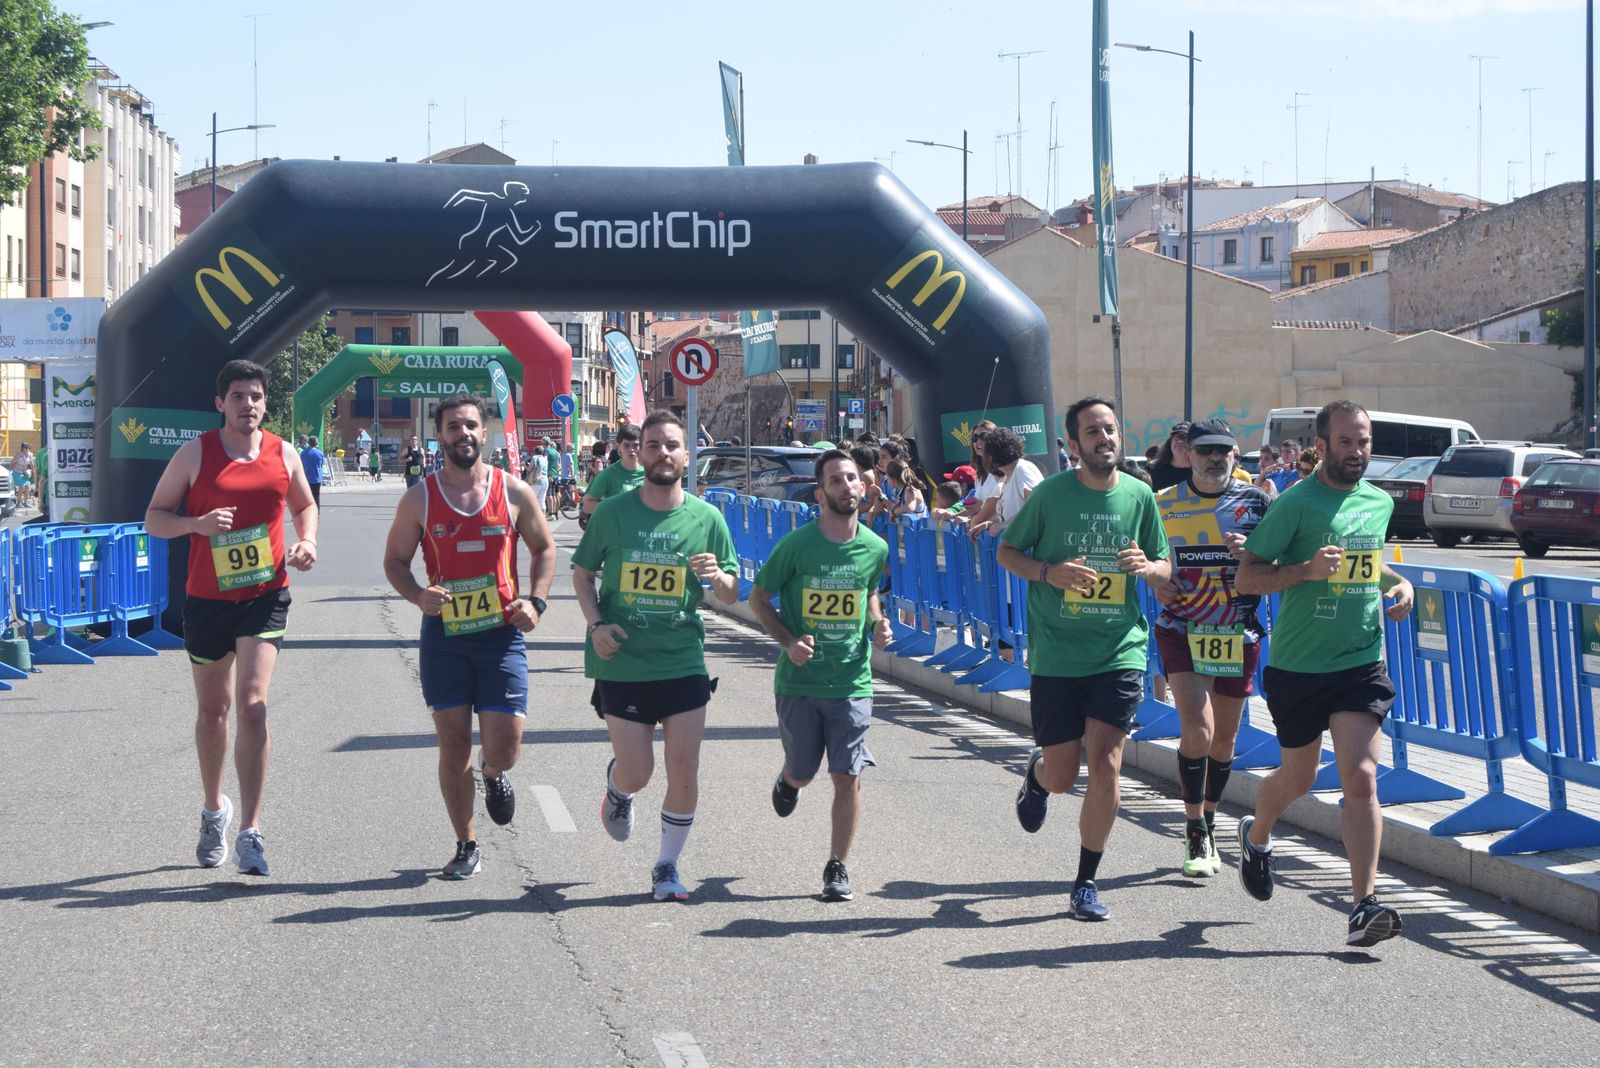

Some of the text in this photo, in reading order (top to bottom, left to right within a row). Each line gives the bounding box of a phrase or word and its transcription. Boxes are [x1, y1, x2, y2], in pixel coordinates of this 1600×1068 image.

[554, 211, 751, 256] SmartChip
[404, 355, 444, 369] CAJA
[400, 382, 470, 394] SALIDA
[148, 427, 206, 439] CAJA RUR
[1012, 424, 1042, 434] RURAL
[228, 544, 260, 570] 99
[1179, 551, 1233, 561] POWERAD
[1346, 554, 1373, 579] 75
[235, 575, 252, 583] CAJA
[629, 566, 675, 592] 126
[451, 591, 491, 618] 174
[808, 593, 855, 616] 226
[460, 622, 477, 630] CAJA
[818, 622, 835, 630] CAJA
[1196, 637, 1233, 660] 181
